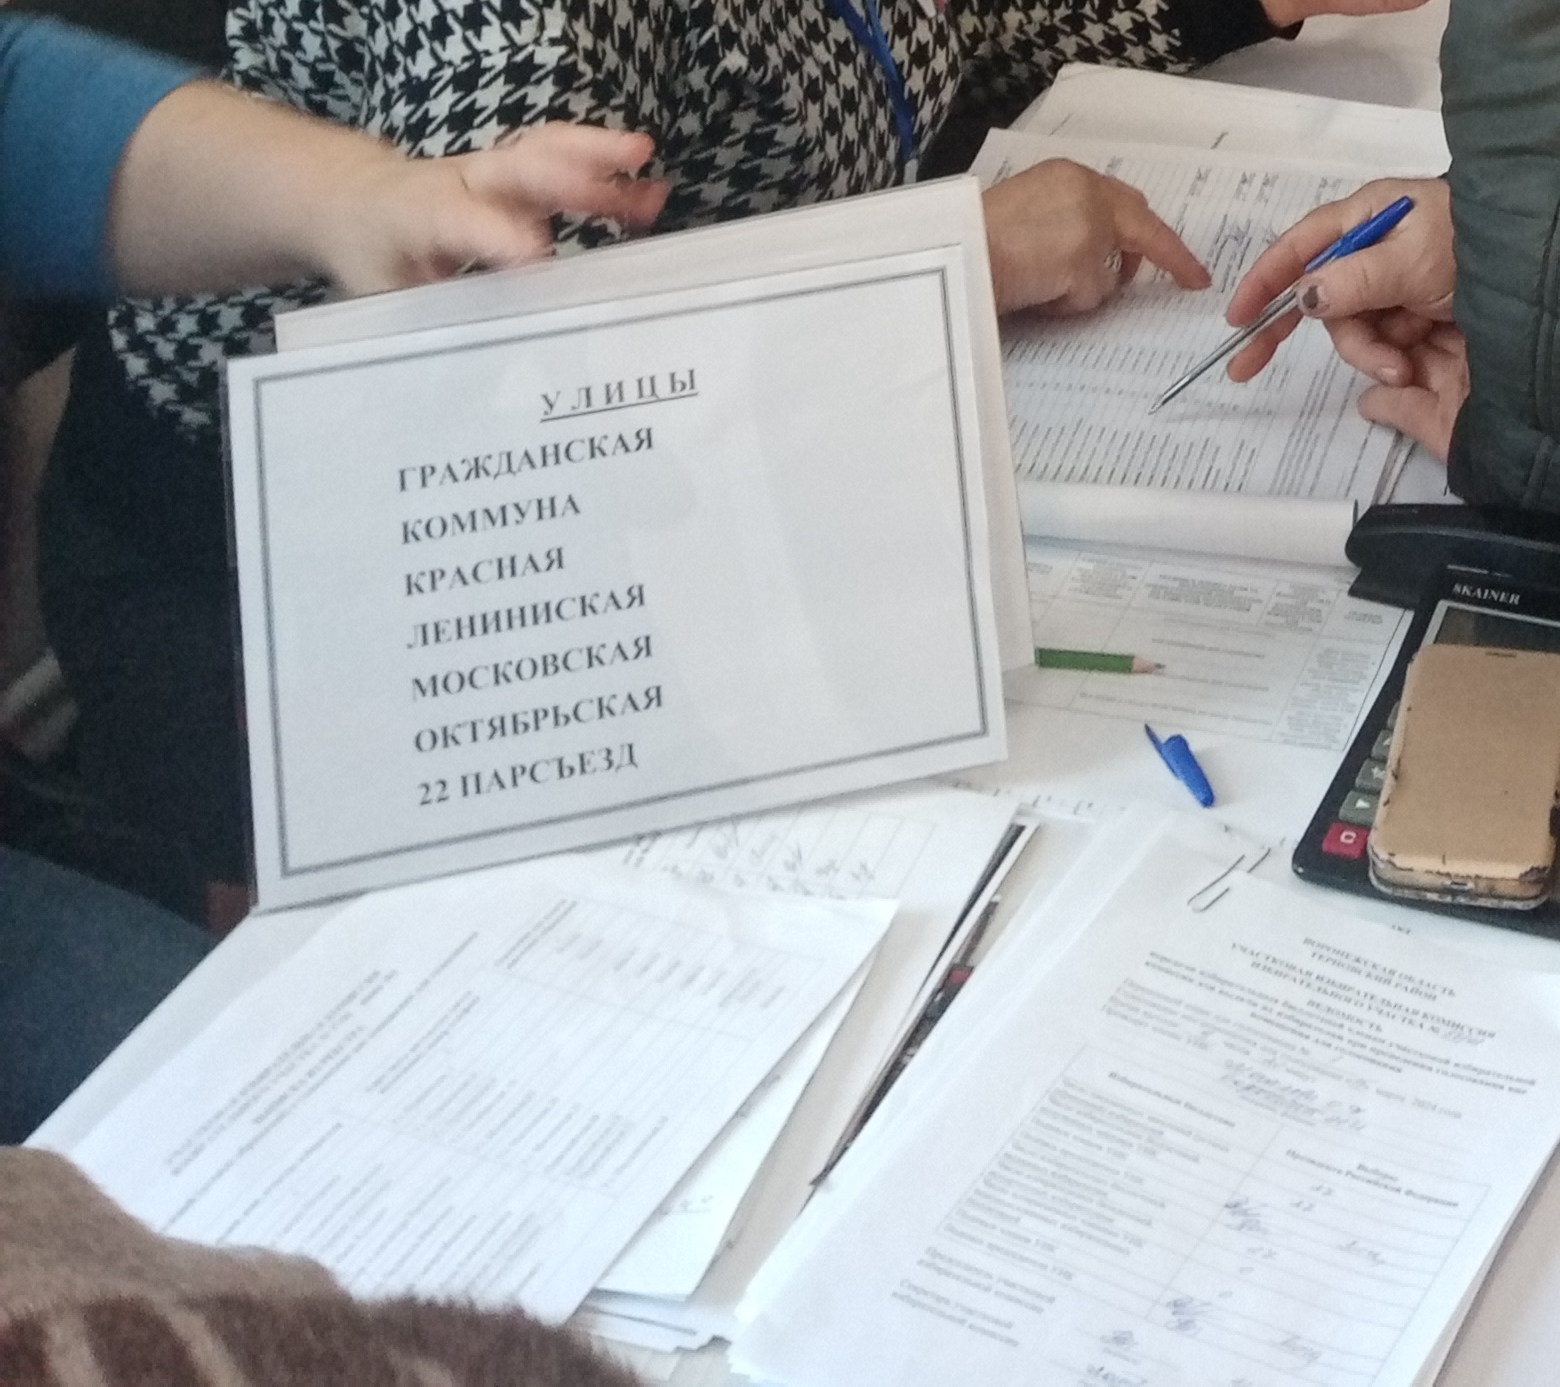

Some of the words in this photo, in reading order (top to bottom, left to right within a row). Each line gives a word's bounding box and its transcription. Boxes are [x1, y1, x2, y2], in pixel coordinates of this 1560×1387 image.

[398, 427, 654, 493] ГРАЖДАНСКАЯ
[401, 494, 581, 545] КОММУНА
[404, 547, 565, 597] КРАСНАЯ
[405, 584, 646, 649] ЛЕНИНИСКАЯ
[411, 635, 653, 702] МОСКОВСКАЯ
[413, 685, 663, 753] ОКТЯБРЬСКАЯ
[418, 779, 450, 806] 22
[460, 743, 639, 798] ПАРСЪЕЗД
